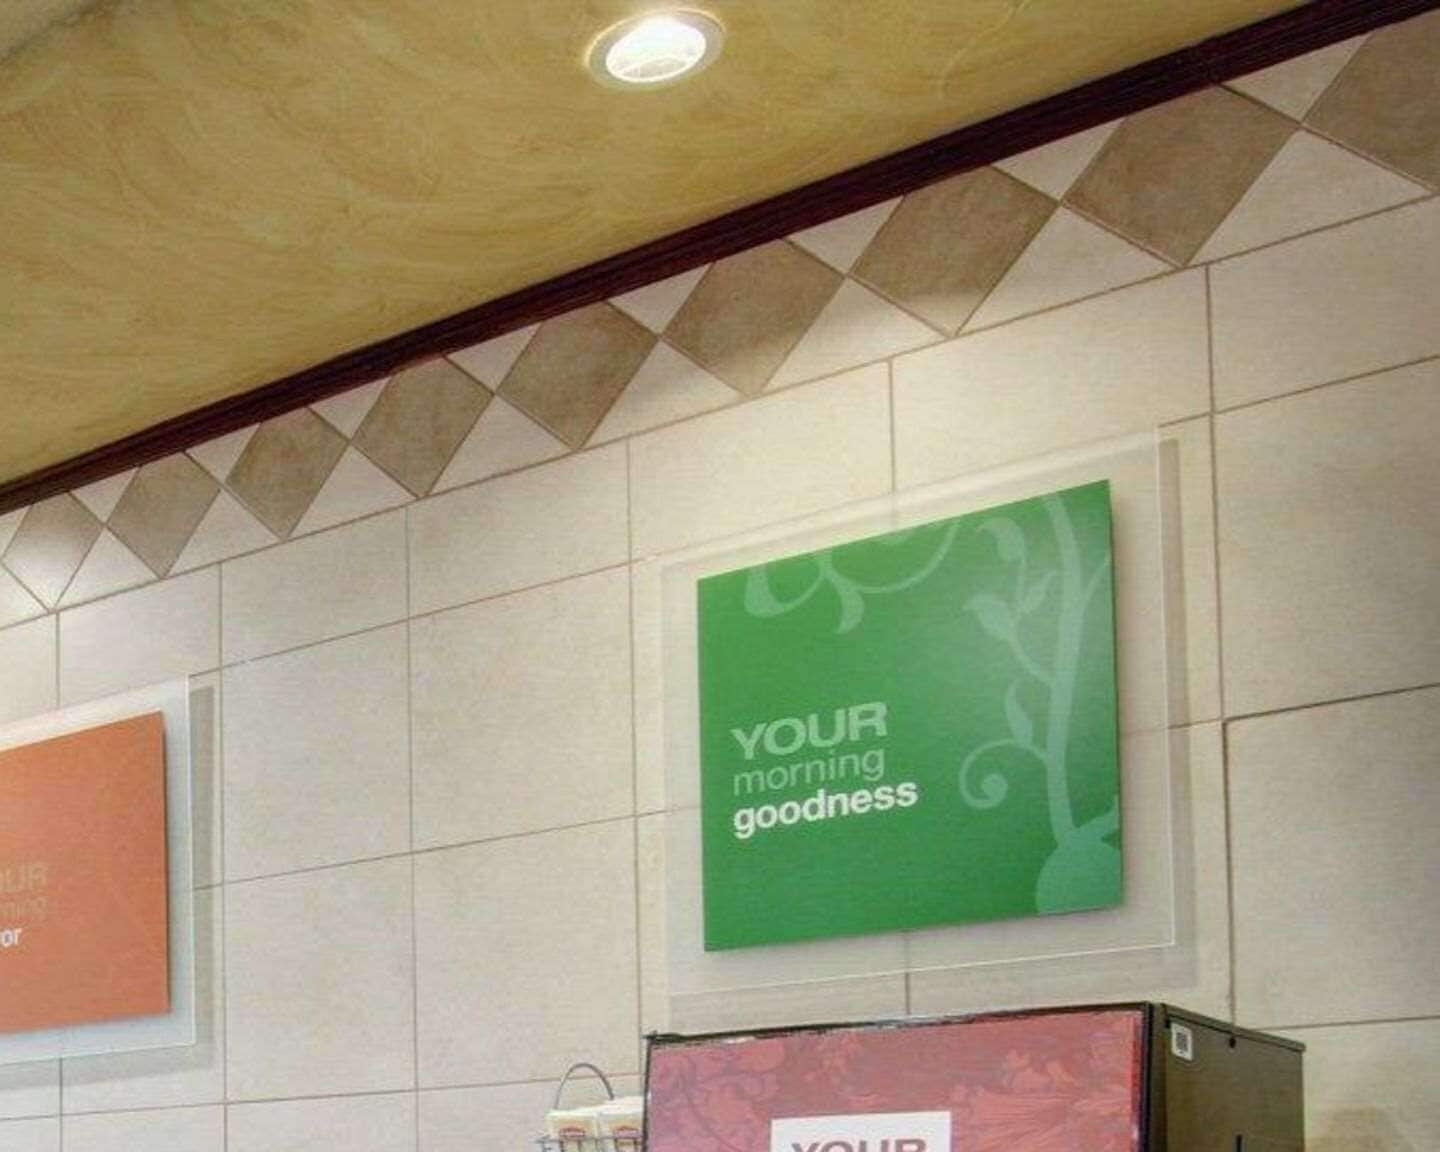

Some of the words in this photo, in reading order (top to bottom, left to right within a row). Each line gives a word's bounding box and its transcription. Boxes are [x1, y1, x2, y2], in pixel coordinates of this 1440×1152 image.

[730, 701, 888, 760] YOUR
[733, 747, 886, 796] morning
[733, 780, 919, 838] goodness
